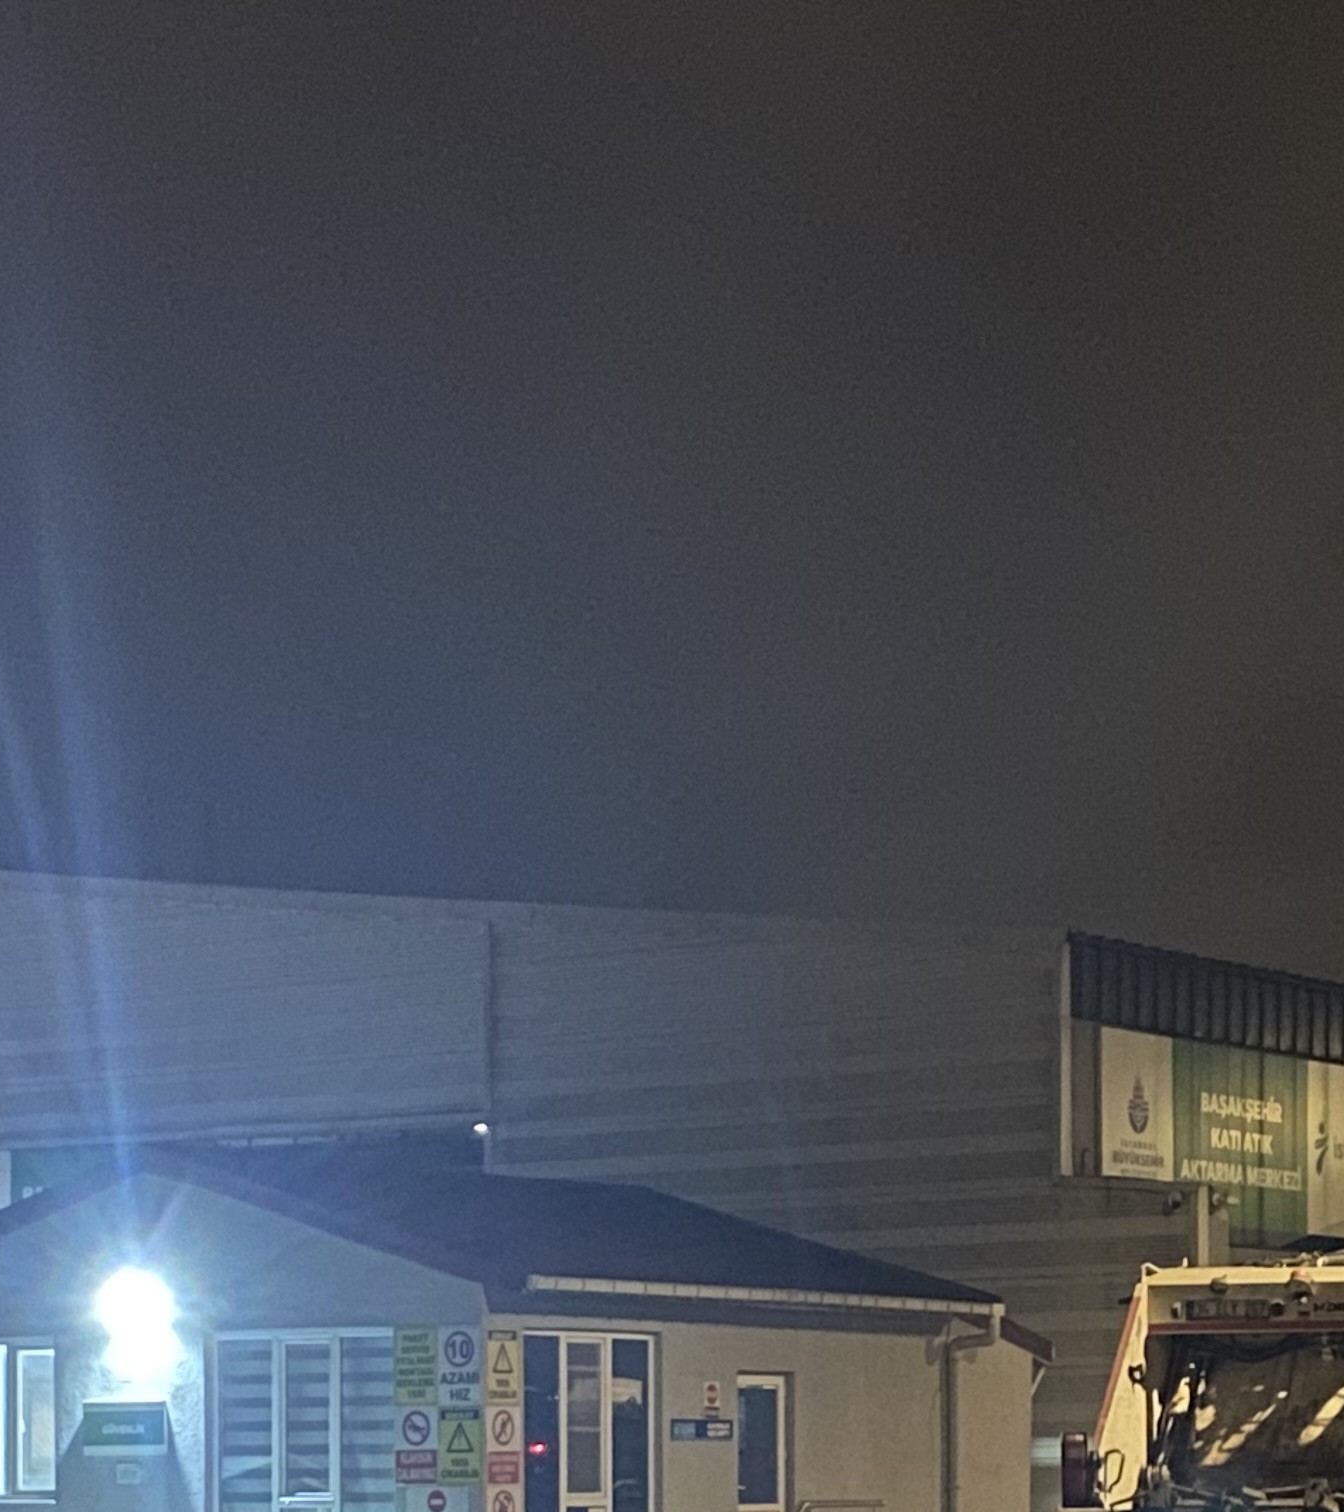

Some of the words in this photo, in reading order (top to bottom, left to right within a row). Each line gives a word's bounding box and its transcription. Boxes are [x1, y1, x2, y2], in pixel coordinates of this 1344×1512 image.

[1201, 1092, 1283, 1124] BAŞAKŞEHİR
[1211, 1127, 1241, 1150] KATI
[1244, 1132, 1273, 1155] ATIK
[1180, 1158, 1244, 1185] AKTARMA
[1247, 1166, 1302, 1191] MERKEZİ
[449, 1340, 470, 1359] 10
[449, 1387, 471, 1401] HIZ
